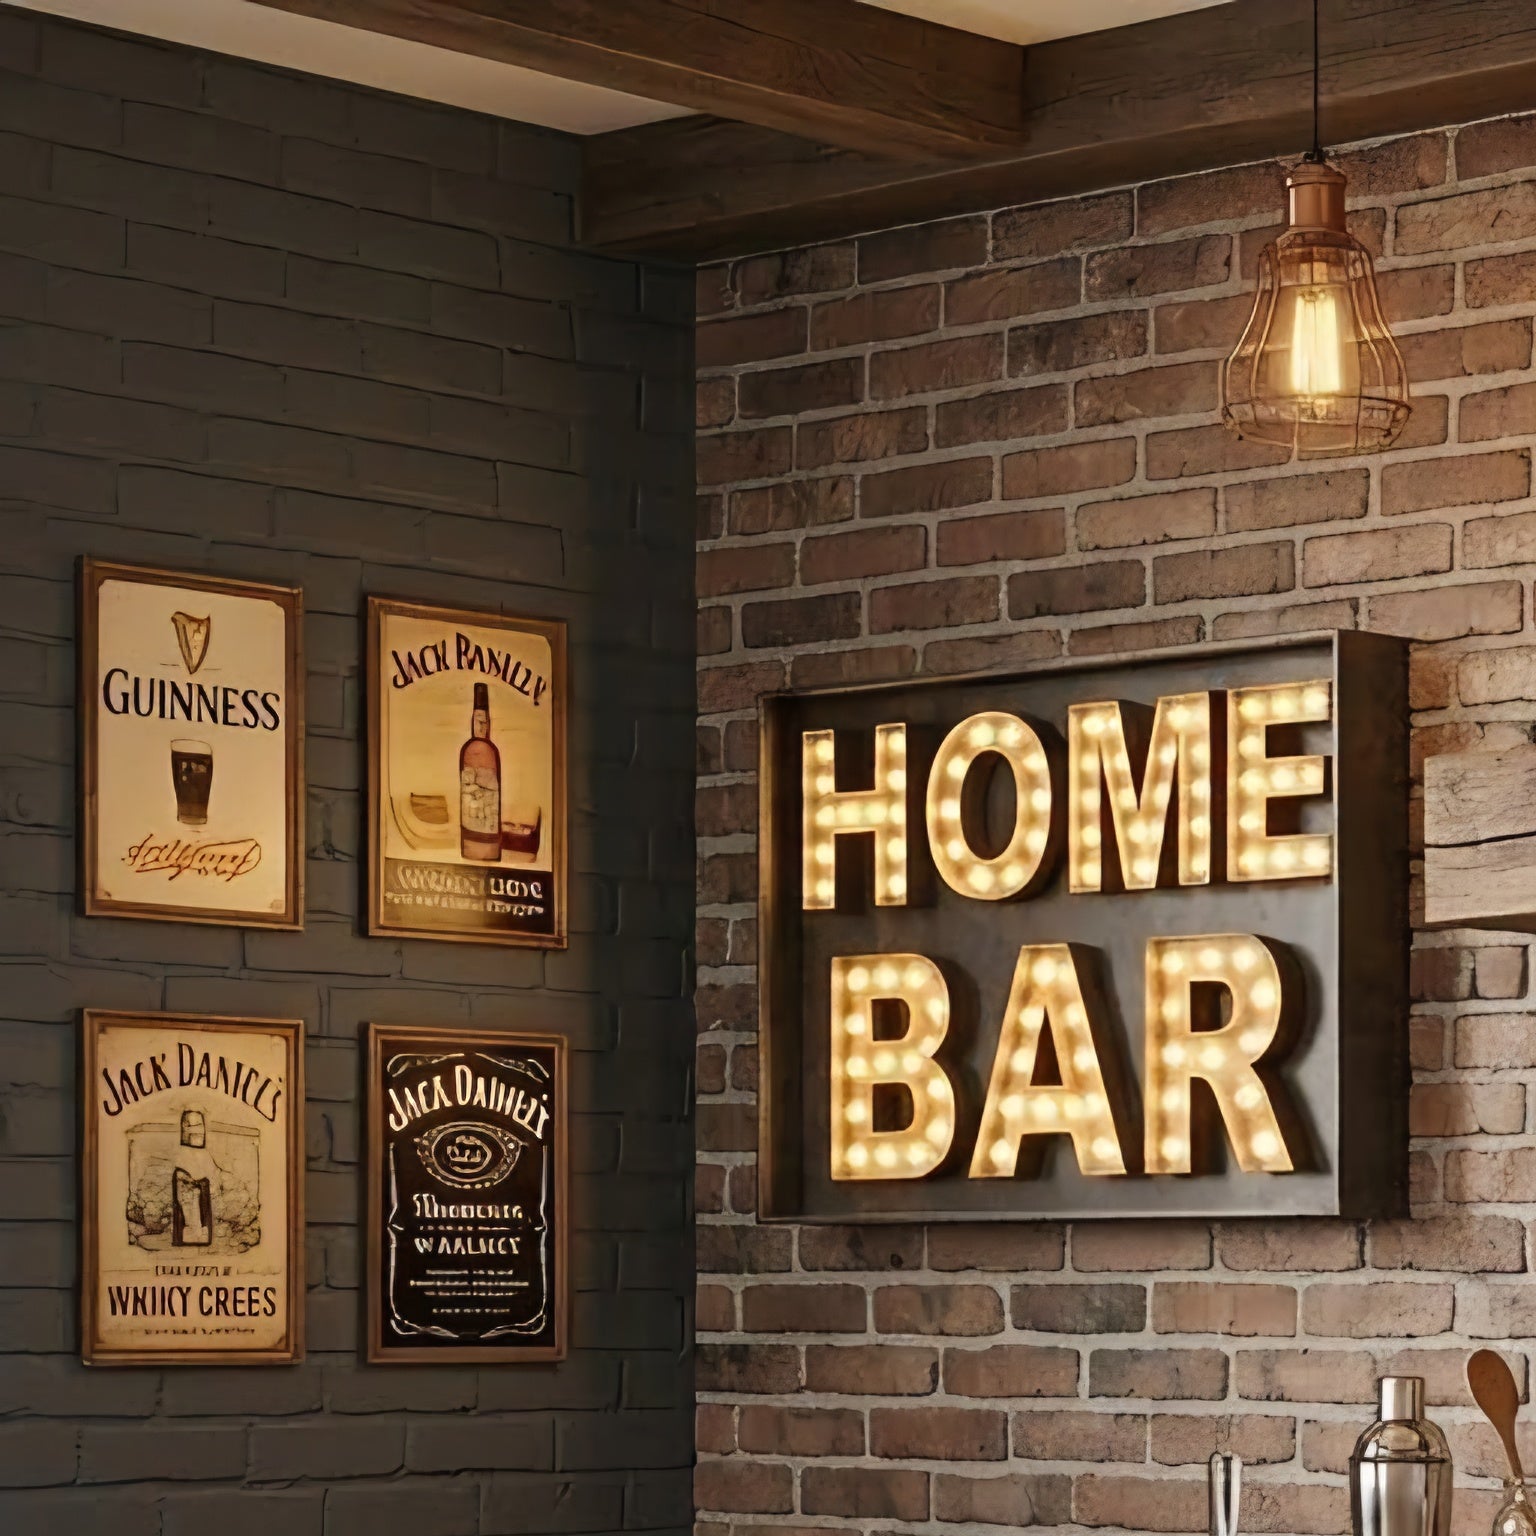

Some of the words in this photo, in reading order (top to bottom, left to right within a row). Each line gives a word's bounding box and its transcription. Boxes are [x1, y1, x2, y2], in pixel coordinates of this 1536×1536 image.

[103, 667, 282, 732] GUINNESS
[802, 681, 1332, 910] HOME
[102, 1053, 171, 1116] JACK
[831, 933, 1294, 1181] BAR
[388, 1075, 453, 1132] JACK
[199, 1286, 276, 1317] CREES
